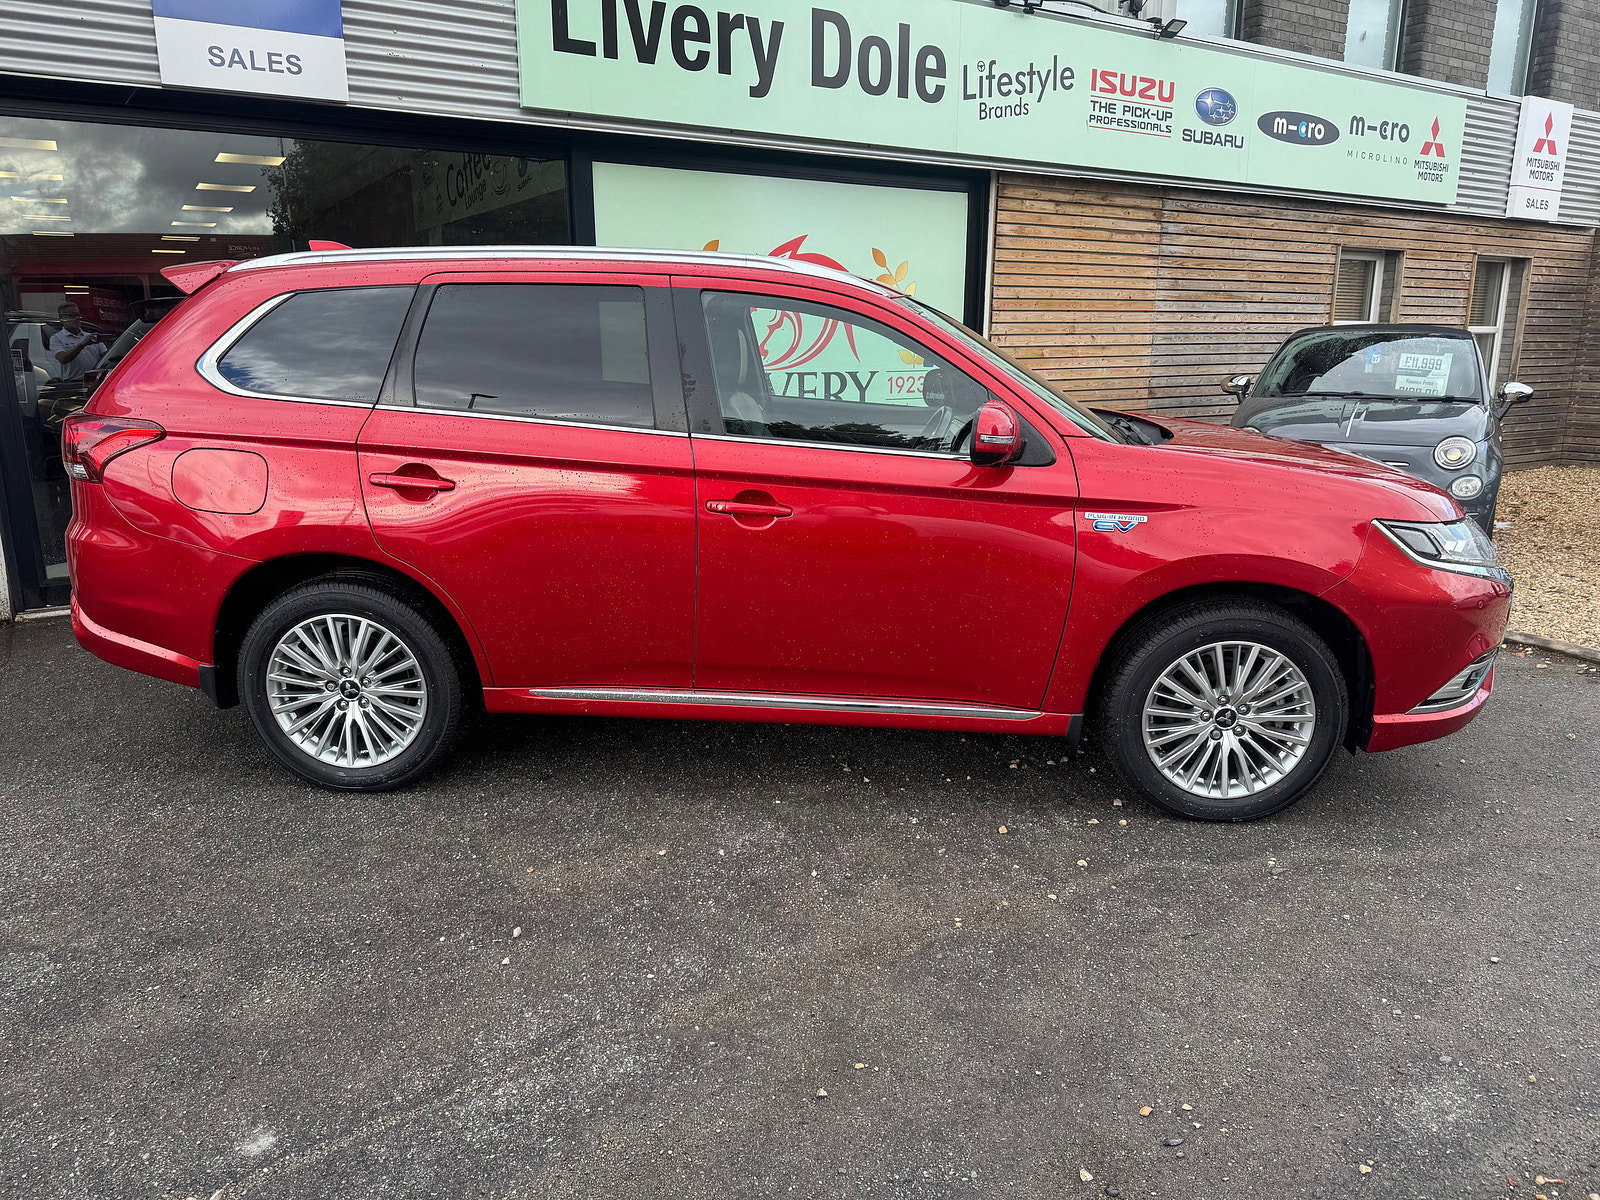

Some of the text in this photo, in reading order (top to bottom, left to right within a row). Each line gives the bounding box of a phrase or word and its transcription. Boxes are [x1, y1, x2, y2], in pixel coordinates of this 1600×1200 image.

[207, 45, 304, 76] SALES
[551, 0, 947, 104] Livery Dole
[962, 54, 1075, 103] Lifestyle
[1090, 68, 1175, 103] ISUZU
[979, 97, 1029, 120] Brands
[1090, 100, 1173, 123] THE PICK-UP
[1088, 113, 1172, 134] PROFESSIONALS
[1182, 128, 1244, 149] SUBARU
[1346, 149, 1409, 166] MICROLINO
[1413, 159, 1449, 173] MITSUBISHI
[1526, 157, 1560, 171] MITSUBISHI
[1417, 171, 1443, 183] MOTORS
[1528, 169, 1554, 182] MOTORS
[1525, 196, 1549, 211] SALES
[1403, 356, 1443, 371] £11,999
[1093, 520, 1139, 533] EV
